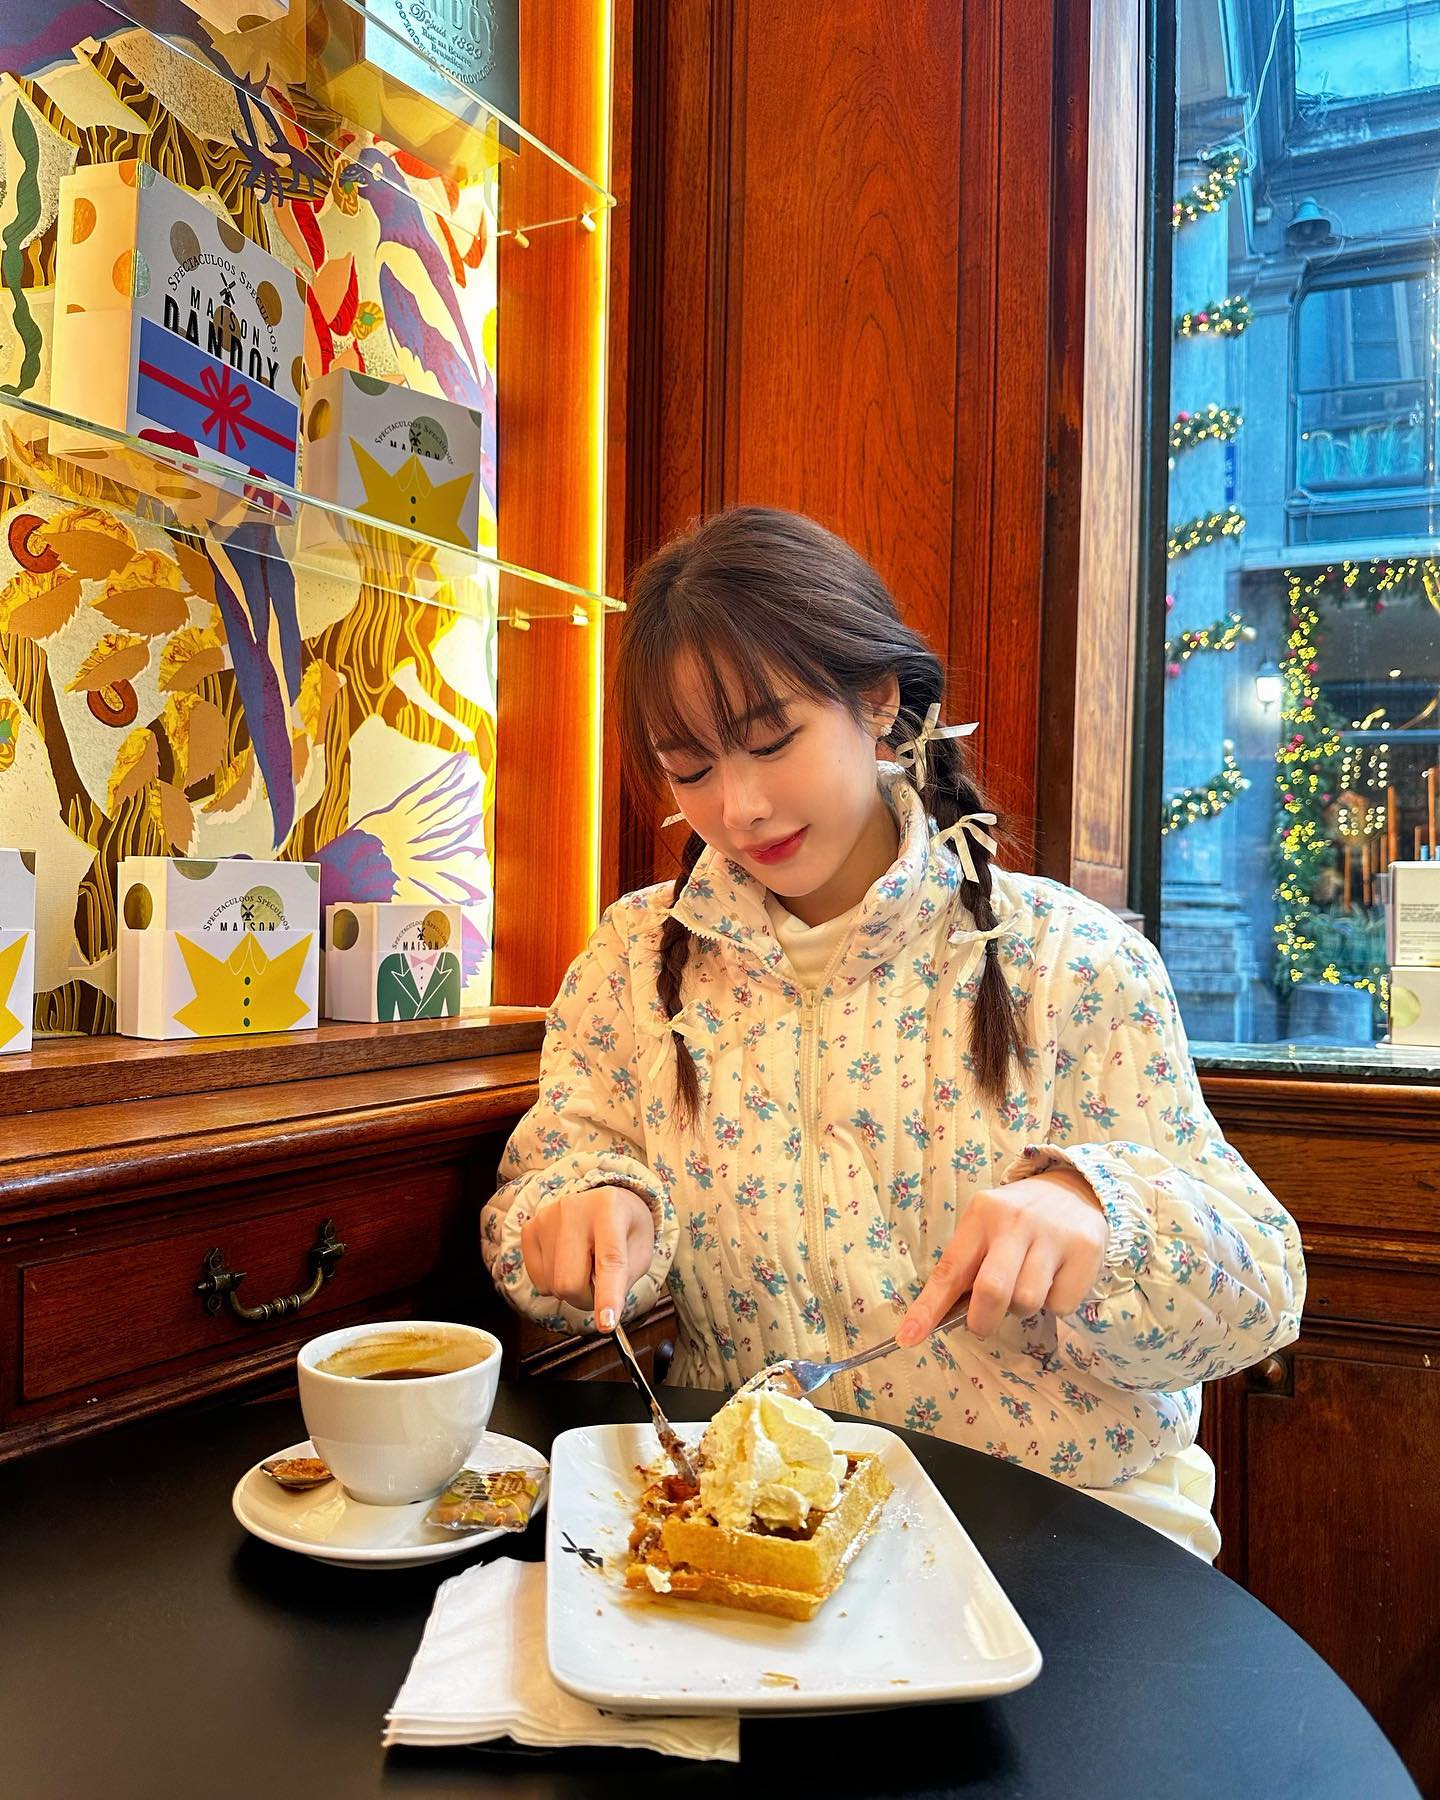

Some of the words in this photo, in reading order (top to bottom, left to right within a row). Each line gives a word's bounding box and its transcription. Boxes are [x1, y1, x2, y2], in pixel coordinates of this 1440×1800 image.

[409, 3, 446, 37] Depuis
[452, 35, 482, 60] 1829
[167, 253, 236, 291] SPECTACULOOS
[238, 271, 279, 353] SPECULOOS
[190, 285, 260, 347] MAISON
[163, 293, 279, 391] DANDOY
[203, 895, 254, 931] SPECTACULOOS
[256, 895, 290, 931] SPECULOOS
[220, 922, 275, 931] MAISON
[403, 941, 439, 951] MAISON
